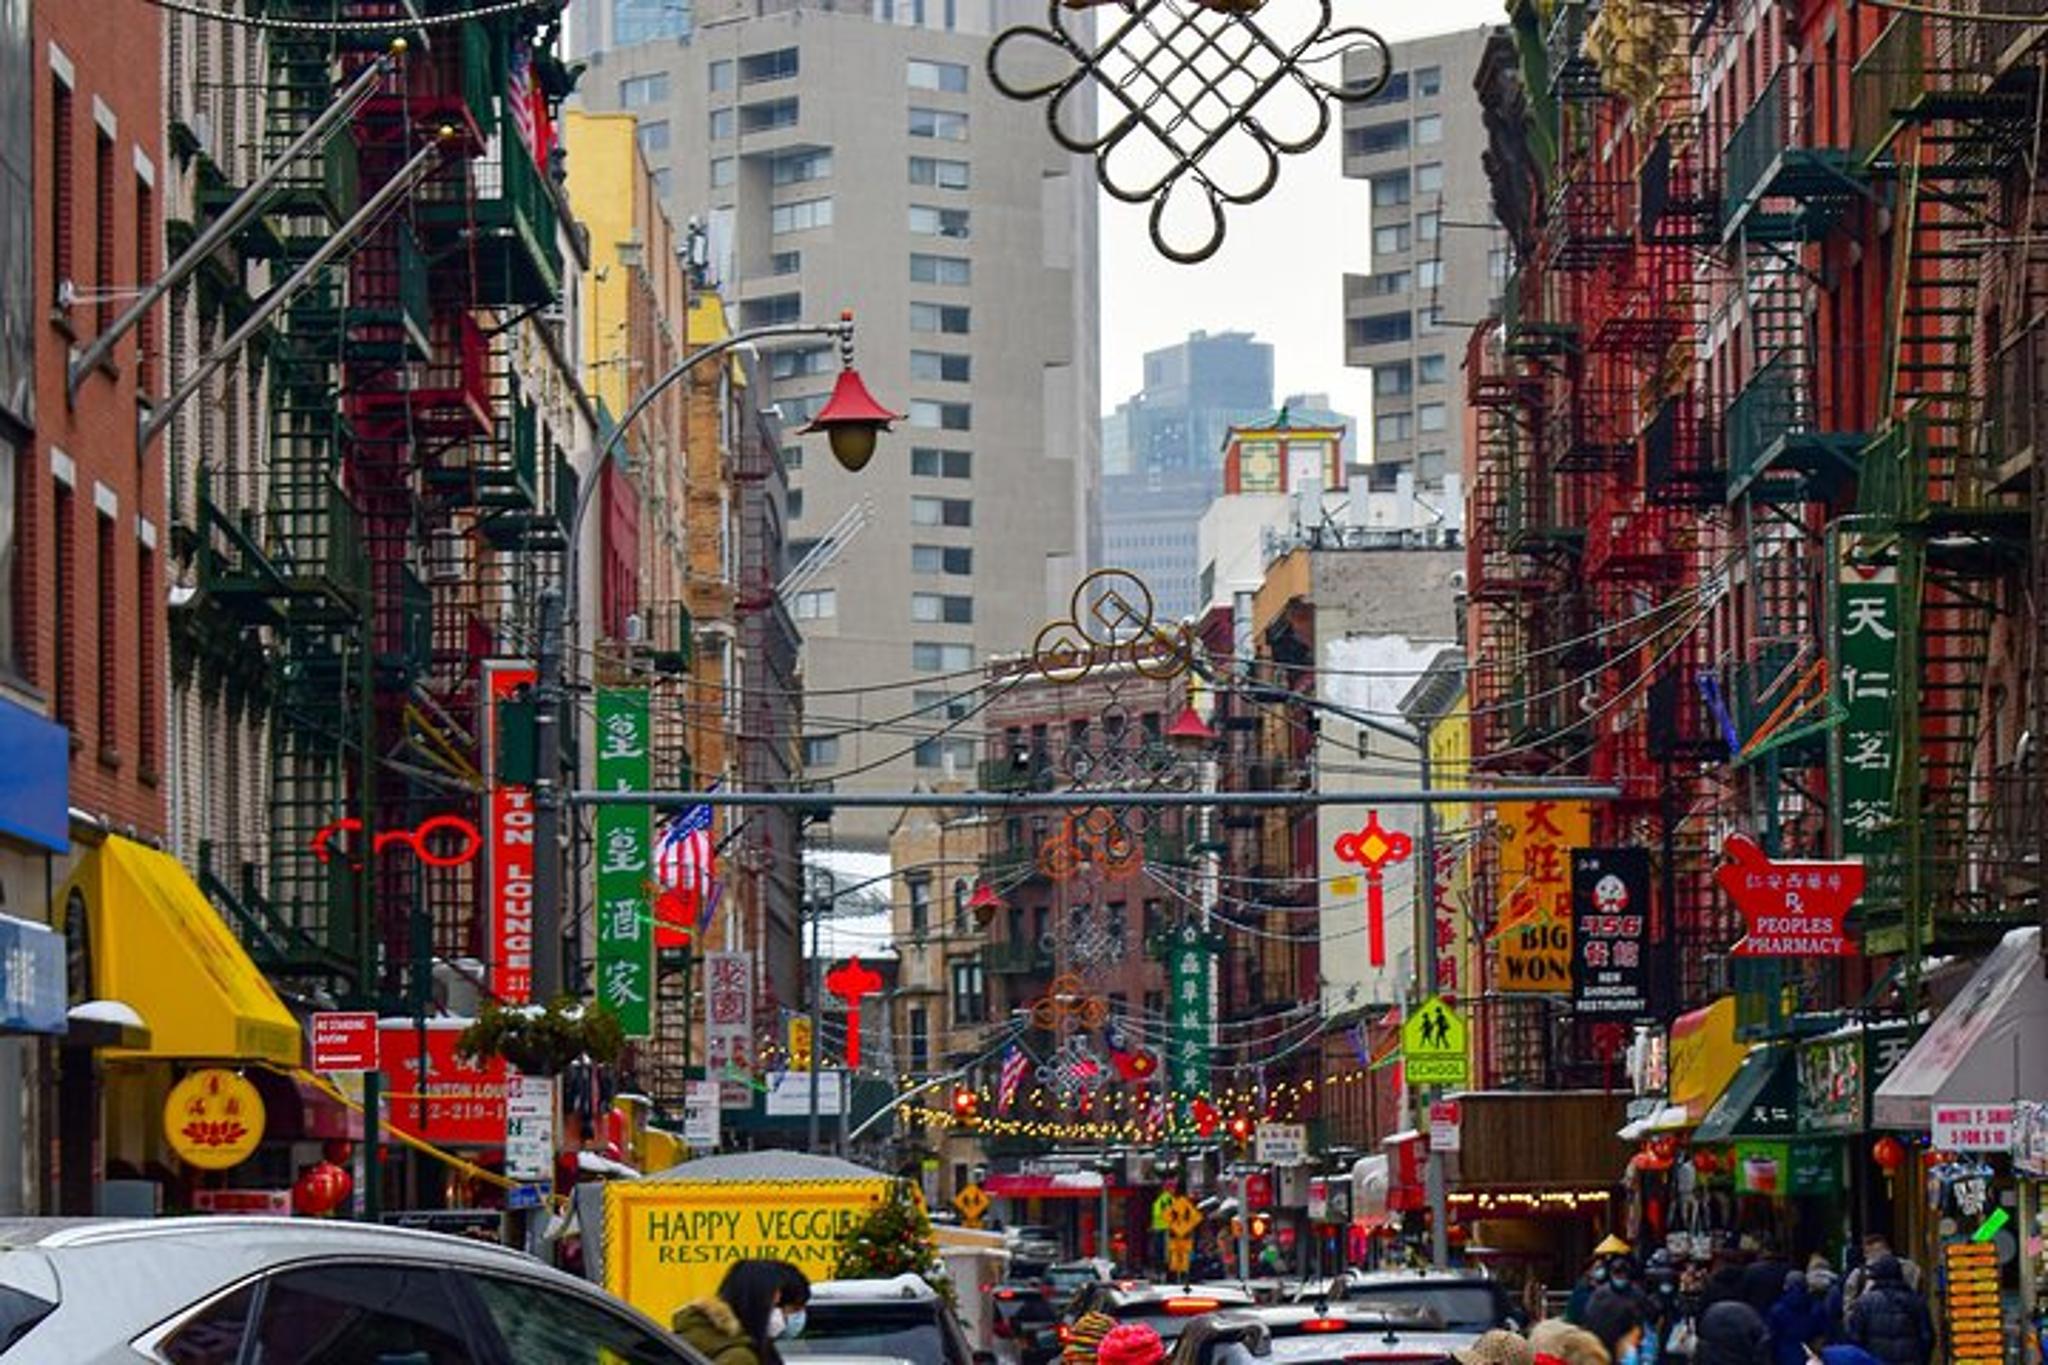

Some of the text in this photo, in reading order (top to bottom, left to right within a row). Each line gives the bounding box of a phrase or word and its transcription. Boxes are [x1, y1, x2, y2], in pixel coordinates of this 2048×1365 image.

[1842, 597, 1895, 842] 天仁茗茶
[503, 864, 533, 969] LOUNGE
[1580, 915, 1642, 937] 456
[1757, 917, 1833, 933] PEOPLES
[1520, 924, 1568, 949] BIG
[1747, 937, 1843, 954] PHARMACY
[1506, 955, 1573, 981] WON
[1576, 999, 1647, 1011] RESTAURANT
[1409, 1061, 1463, 1076] SCHOOL
[1937, 1110, 1971, 1124] WHITE
[1961, 1130, 1981, 1144] FOR
[648, 1209, 851, 1242] HAPPY VEGGIE
[659, 1244, 844, 1263] RESTAURANT
